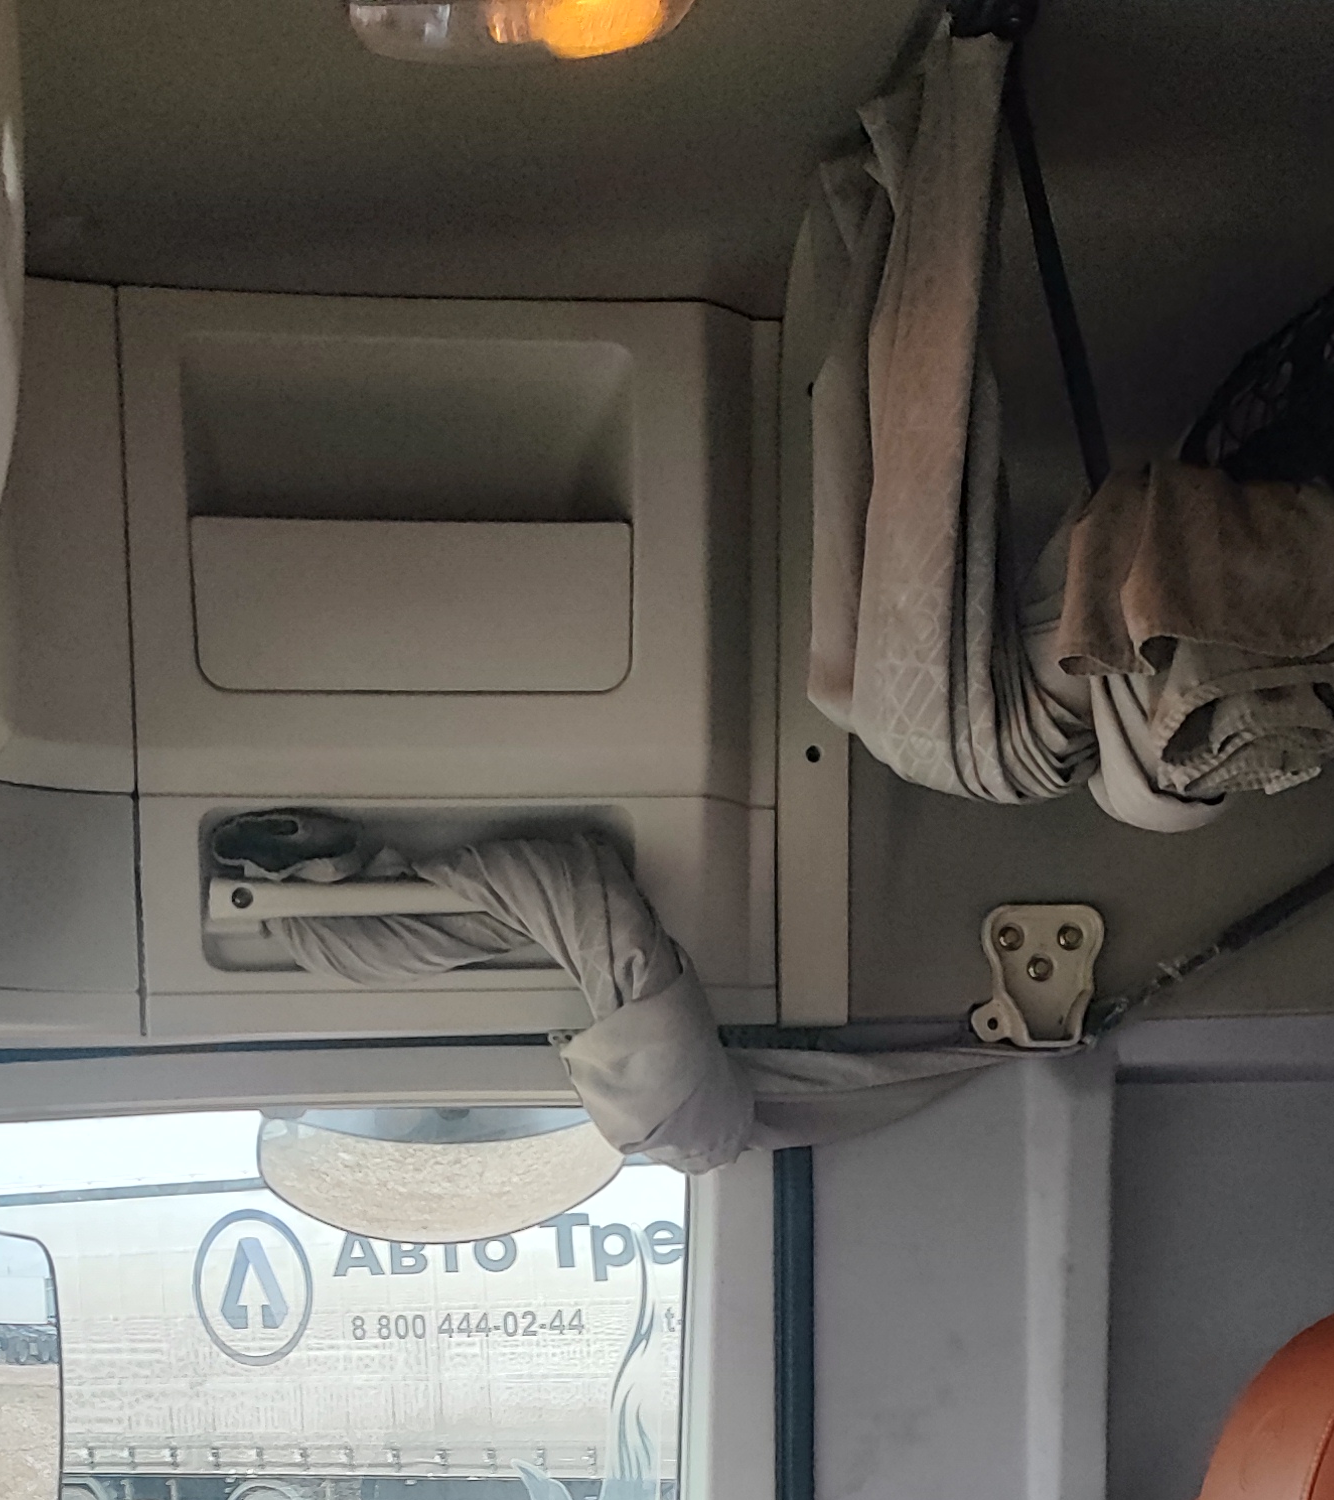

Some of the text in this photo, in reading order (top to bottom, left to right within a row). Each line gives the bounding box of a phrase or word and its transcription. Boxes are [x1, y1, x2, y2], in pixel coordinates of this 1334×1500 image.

[351, 1309, 585, 1340] 8 800 444-02-44
